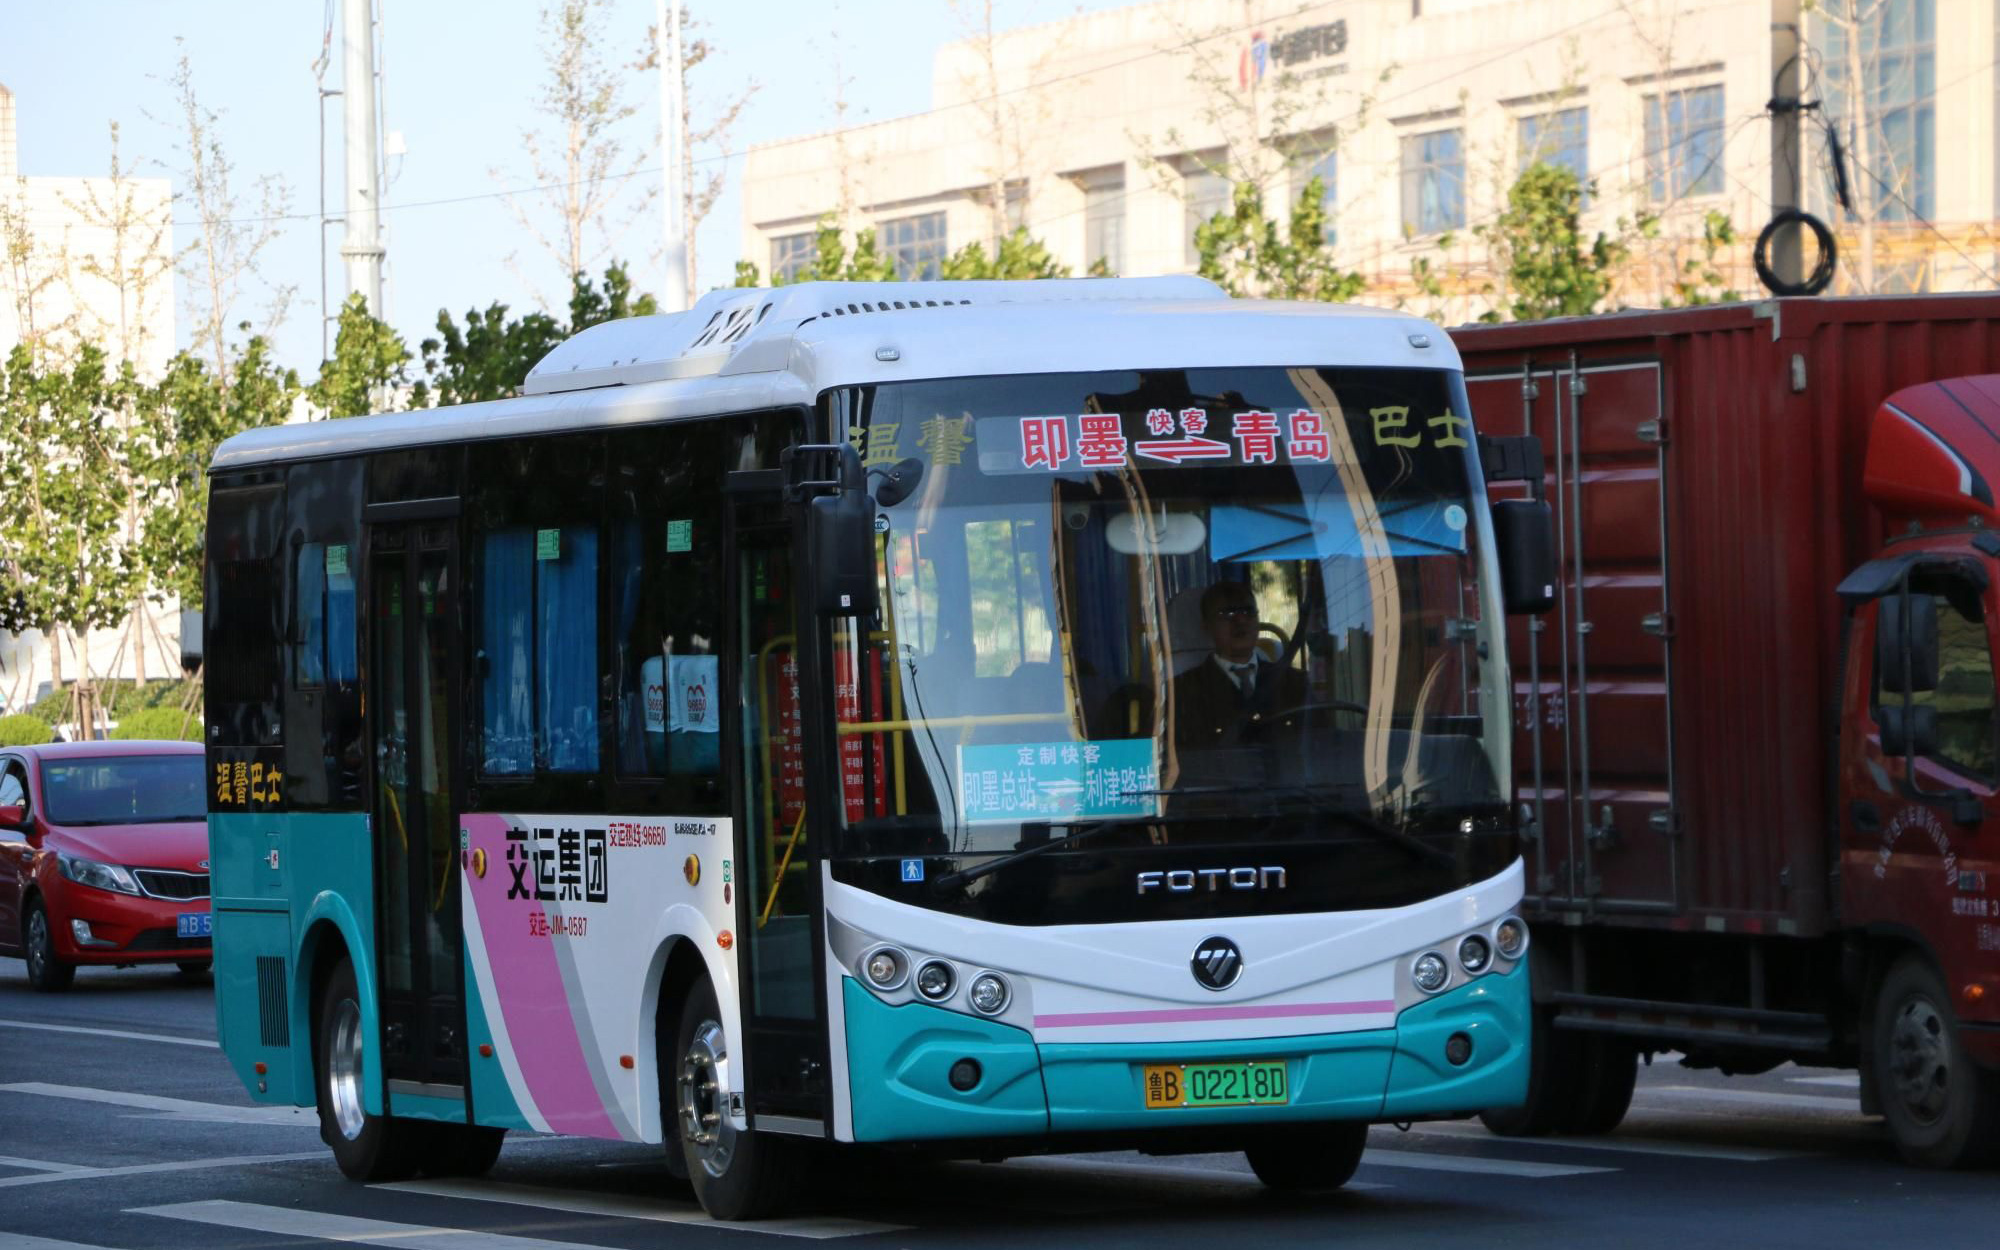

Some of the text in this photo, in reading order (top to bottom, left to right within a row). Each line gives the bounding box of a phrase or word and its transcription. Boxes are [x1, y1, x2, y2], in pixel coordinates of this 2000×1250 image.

[1020, 409, 1330, 471] 即墨 青岛
[1147, 408, 1207, 435] 快客
[1369, 405, 1469, 448] 巴士
[1017, 744, 1101, 766] 定制快客
[216, 761, 282, 805] 温馨巴士
[963, 768, 1036, 812] 即墨总站
[506, 826, 608, 903] 交运集团
[1136, 866, 1287, 895] FOTON
